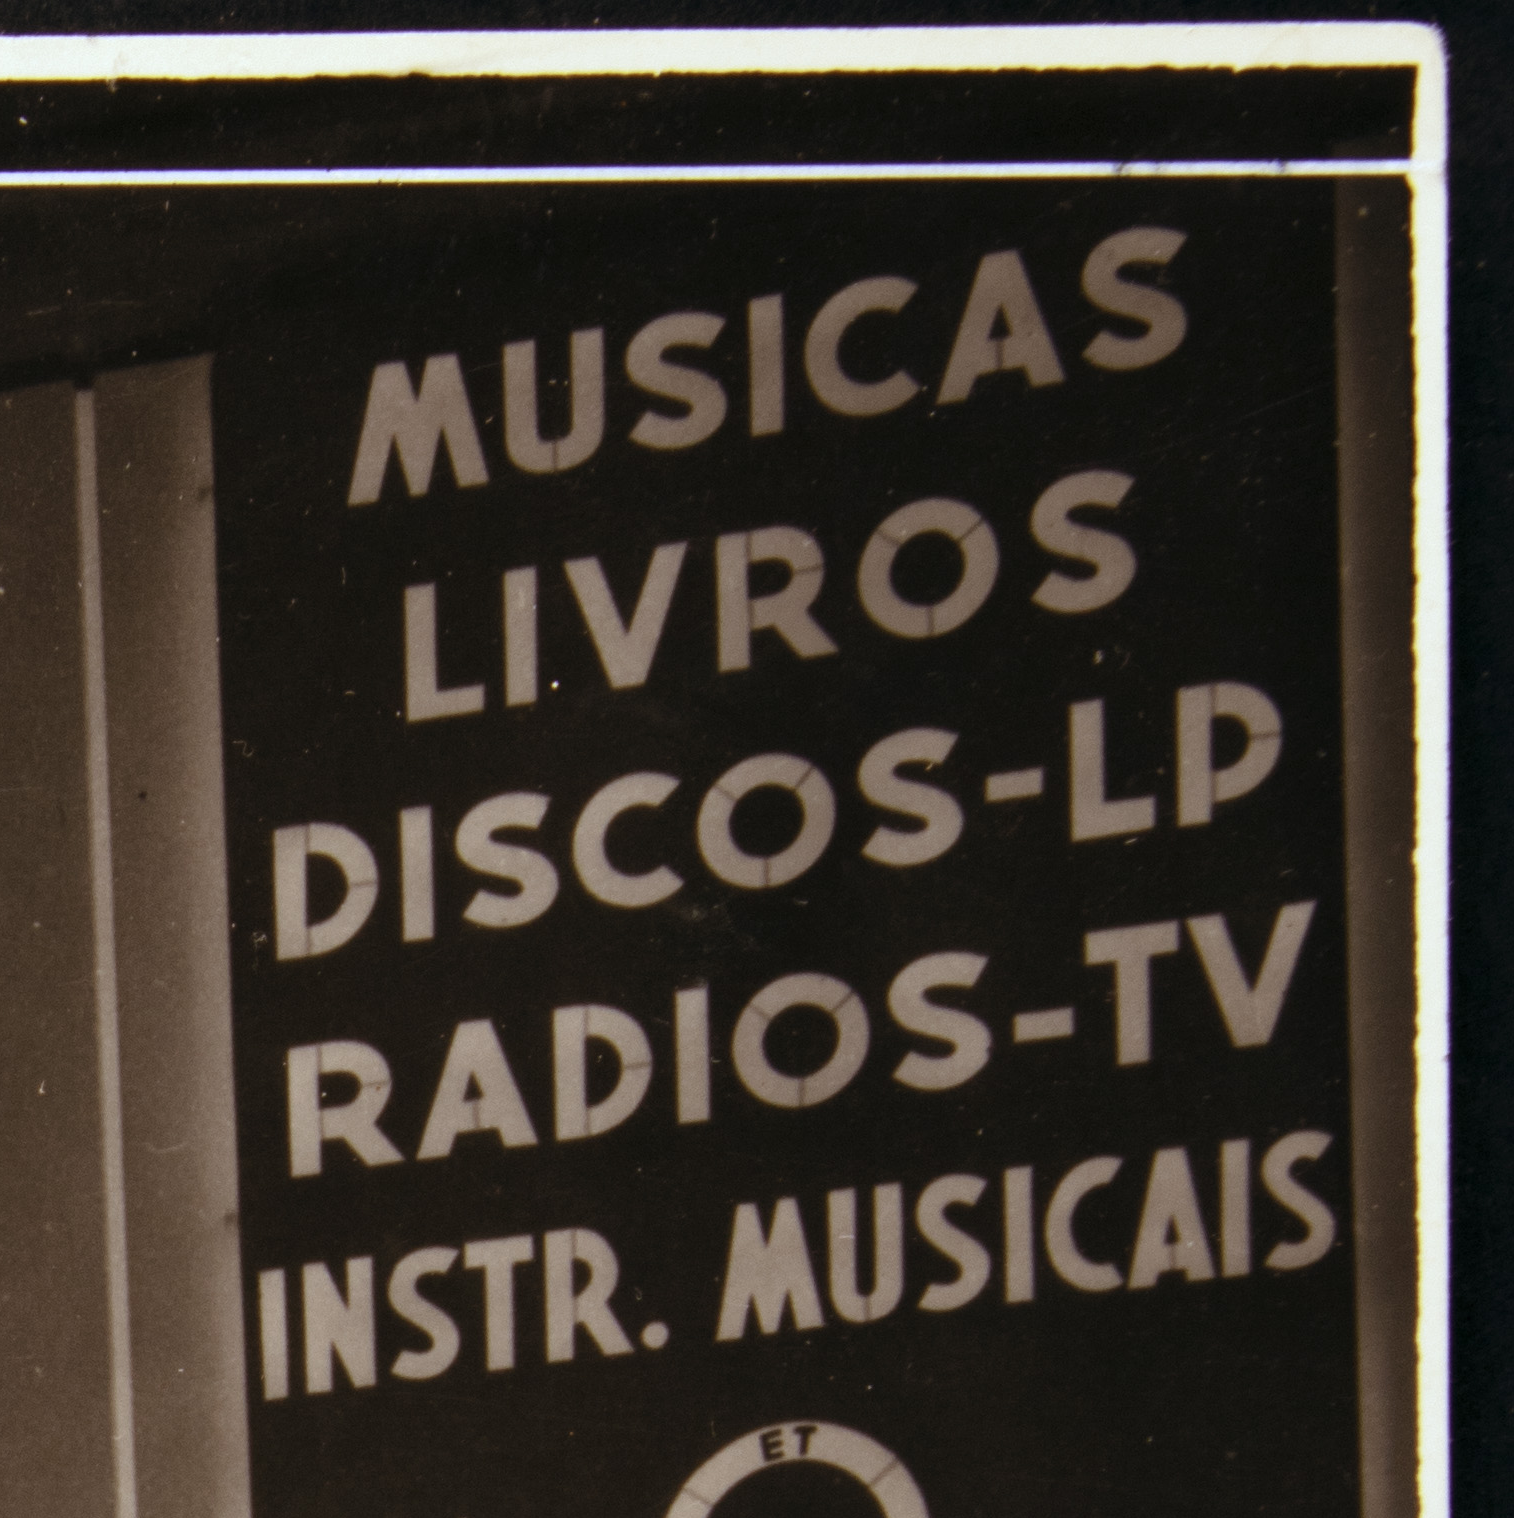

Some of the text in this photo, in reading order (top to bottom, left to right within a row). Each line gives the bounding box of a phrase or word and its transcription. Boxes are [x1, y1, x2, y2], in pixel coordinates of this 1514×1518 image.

[347, 228, 1186, 506] MUSICAS
[403, 470, 1136, 723] LIVROS
[271, 681, 1283, 962] DISCOS-LP
[283, 900, 1315, 1179] RADIOS-TV
[257, 1130, 1335, 1402] INSTR. MUSICAIS
[760, 1424, 819, 1463] ET
